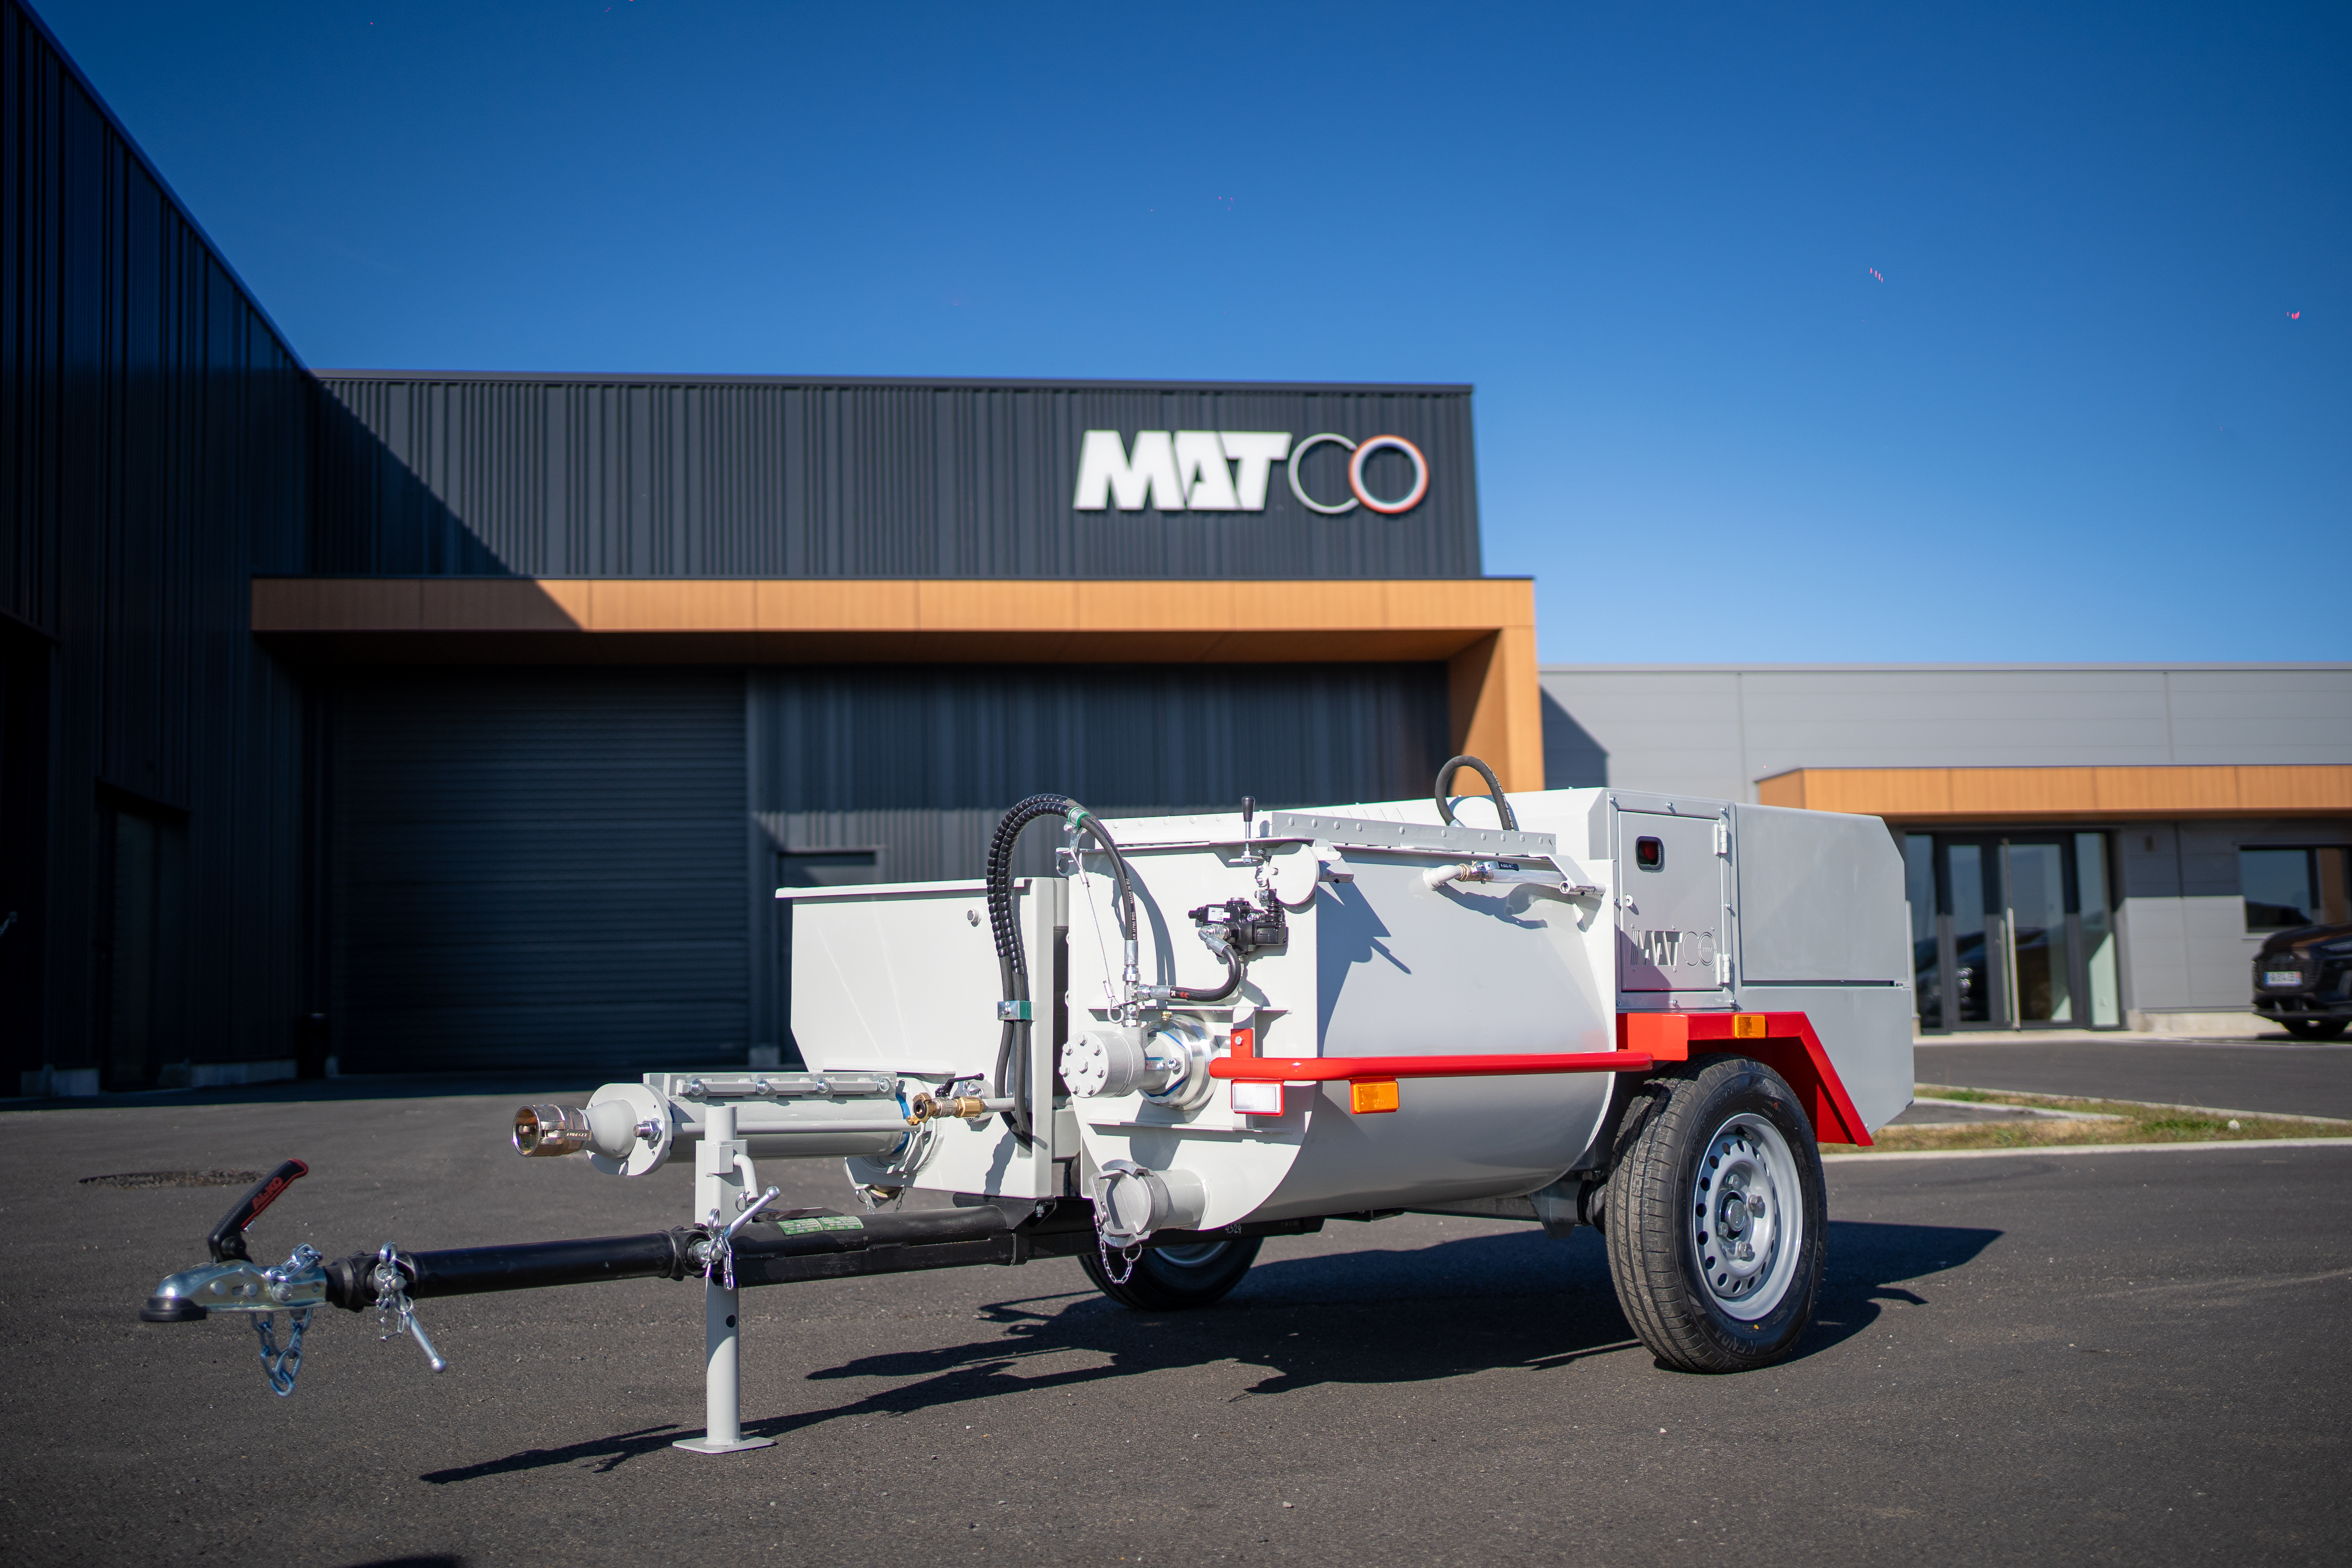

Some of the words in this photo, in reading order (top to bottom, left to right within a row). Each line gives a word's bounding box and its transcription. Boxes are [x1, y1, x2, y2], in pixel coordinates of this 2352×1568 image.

[1073, 430, 1429, 514] MATCO
[1631, 930, 1717, 966] MATCO
[252, 1177, 283, 1211] AL-KO
[1714, 1325, 1757, 1355] KENDA
